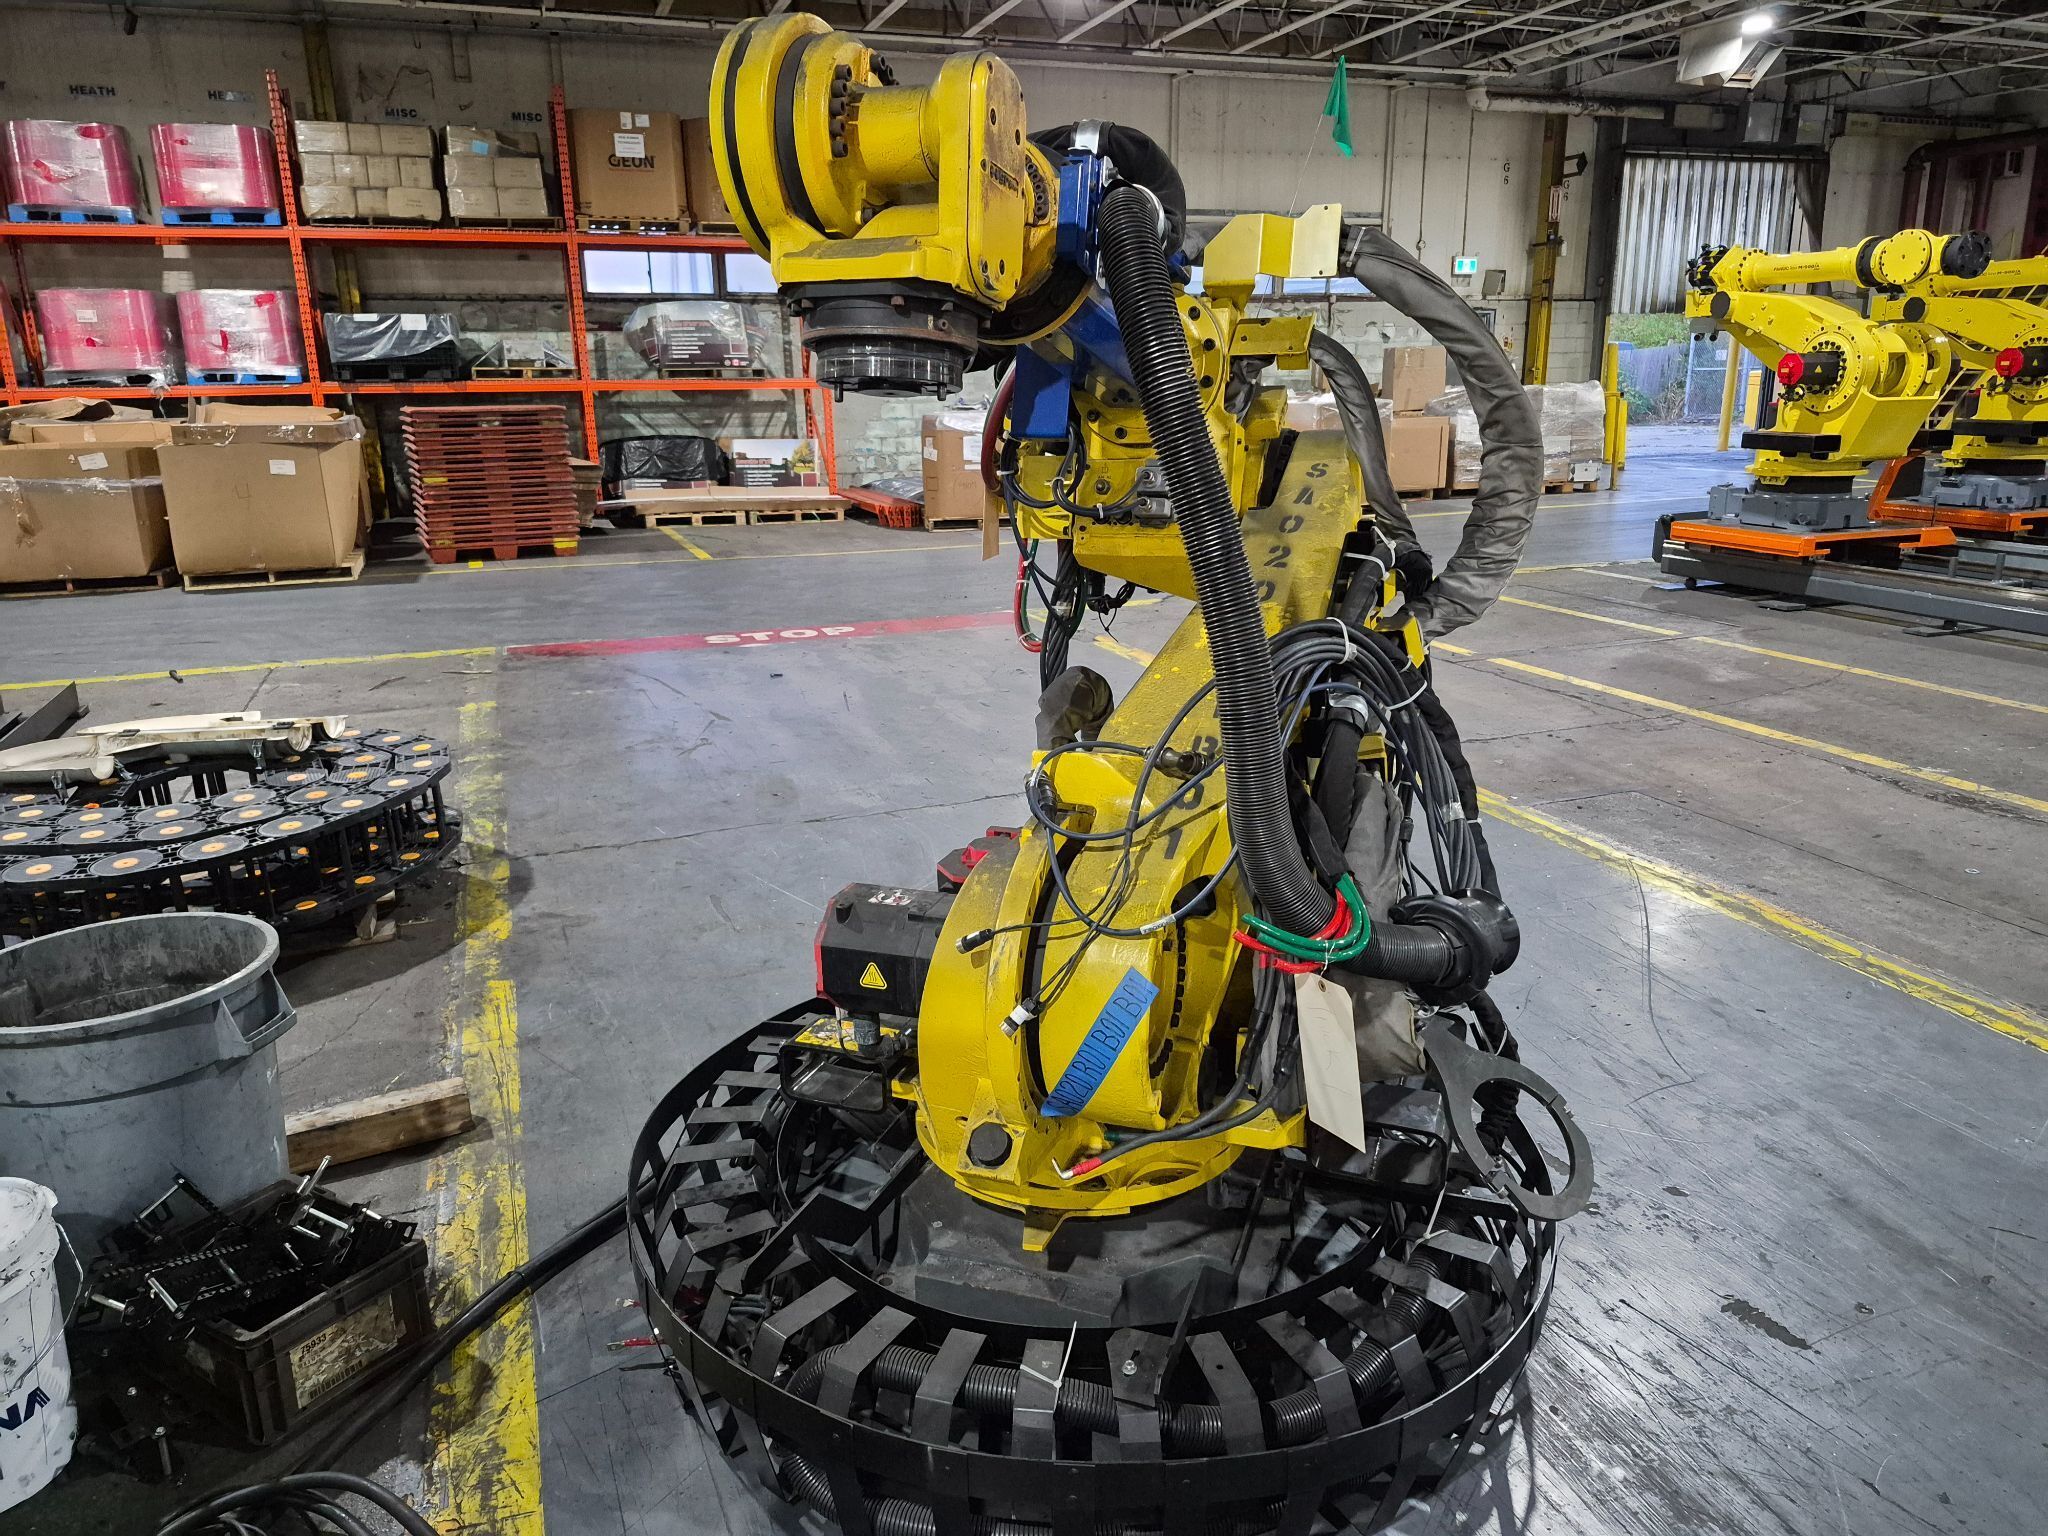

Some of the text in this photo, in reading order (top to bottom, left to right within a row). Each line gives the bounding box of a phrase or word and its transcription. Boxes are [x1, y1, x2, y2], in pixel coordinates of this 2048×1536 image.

[69, 85, 116, 97] HEATH
[385, 108, 418, 118] MISC
[511, 112, 543, 122] MISC
[608, 154, 656, 169] GEON
[704, 626, 855, 644] STOP
[1090, 1011, 1130, 1053] B01
[1072, 1043, 1111, 1082] R01
